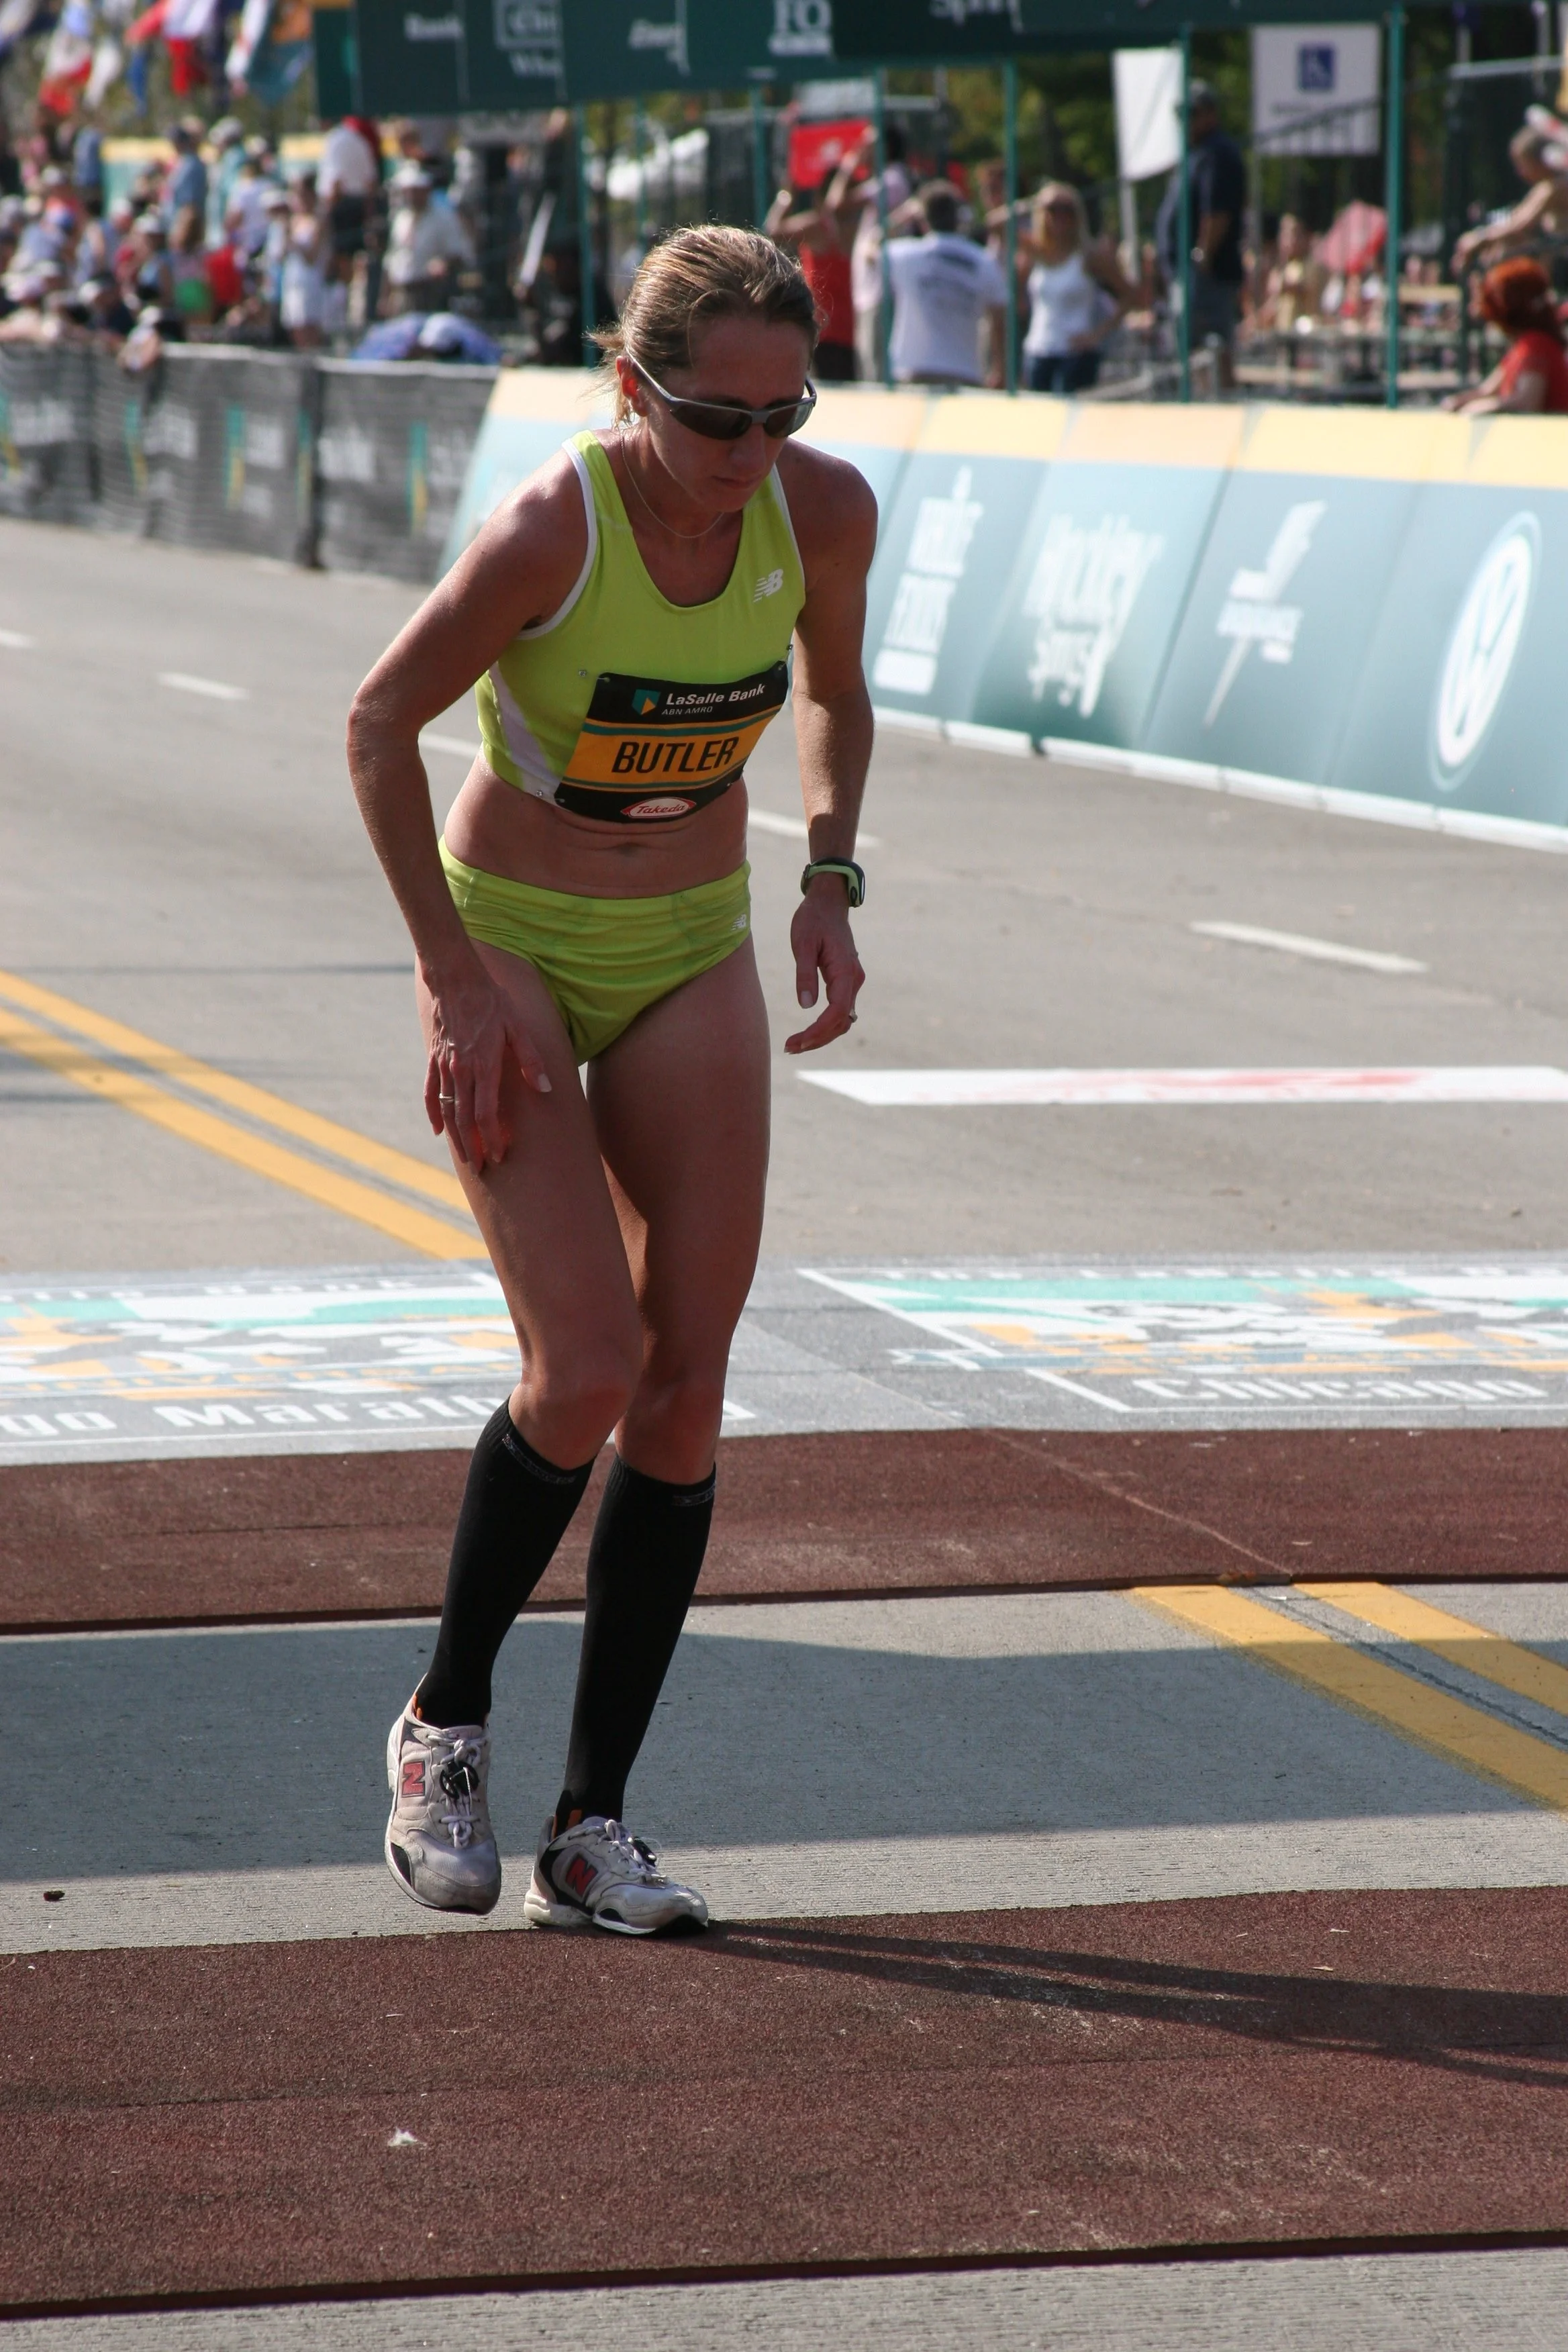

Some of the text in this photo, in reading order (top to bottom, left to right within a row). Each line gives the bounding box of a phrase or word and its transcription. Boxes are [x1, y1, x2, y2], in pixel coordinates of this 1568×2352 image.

[666, 683, 765, 705] LaSalle Bank
[684, 706, 713, 715] AMRO
[611, 736, 740, 773] BUTLER
[636, 803, 685, 814] Takeda
